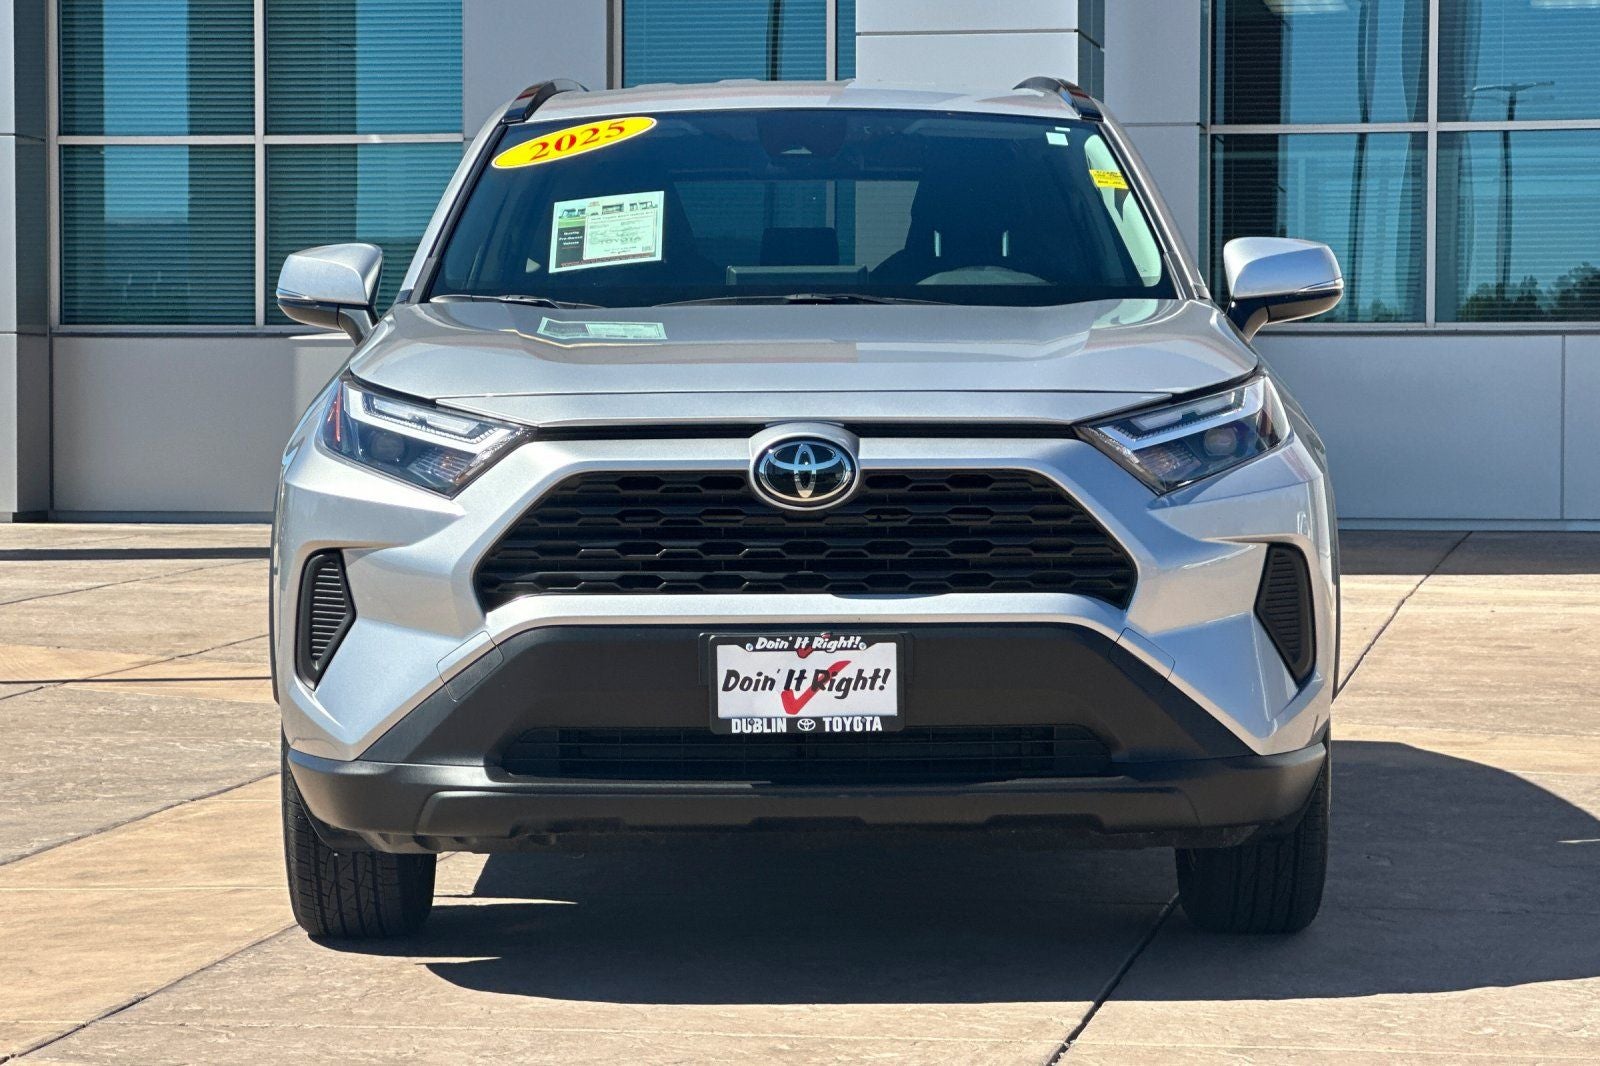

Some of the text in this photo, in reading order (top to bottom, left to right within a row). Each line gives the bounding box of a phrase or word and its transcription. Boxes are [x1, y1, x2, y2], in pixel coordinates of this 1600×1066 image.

[529, 120, 626, 161] 2025
[755, 635, 861, 653] Doin' It Right!
[722, 668, 891, 699] Doin' It Right!
[731, 716, 883, 733] DUBLIN TOYOTA
